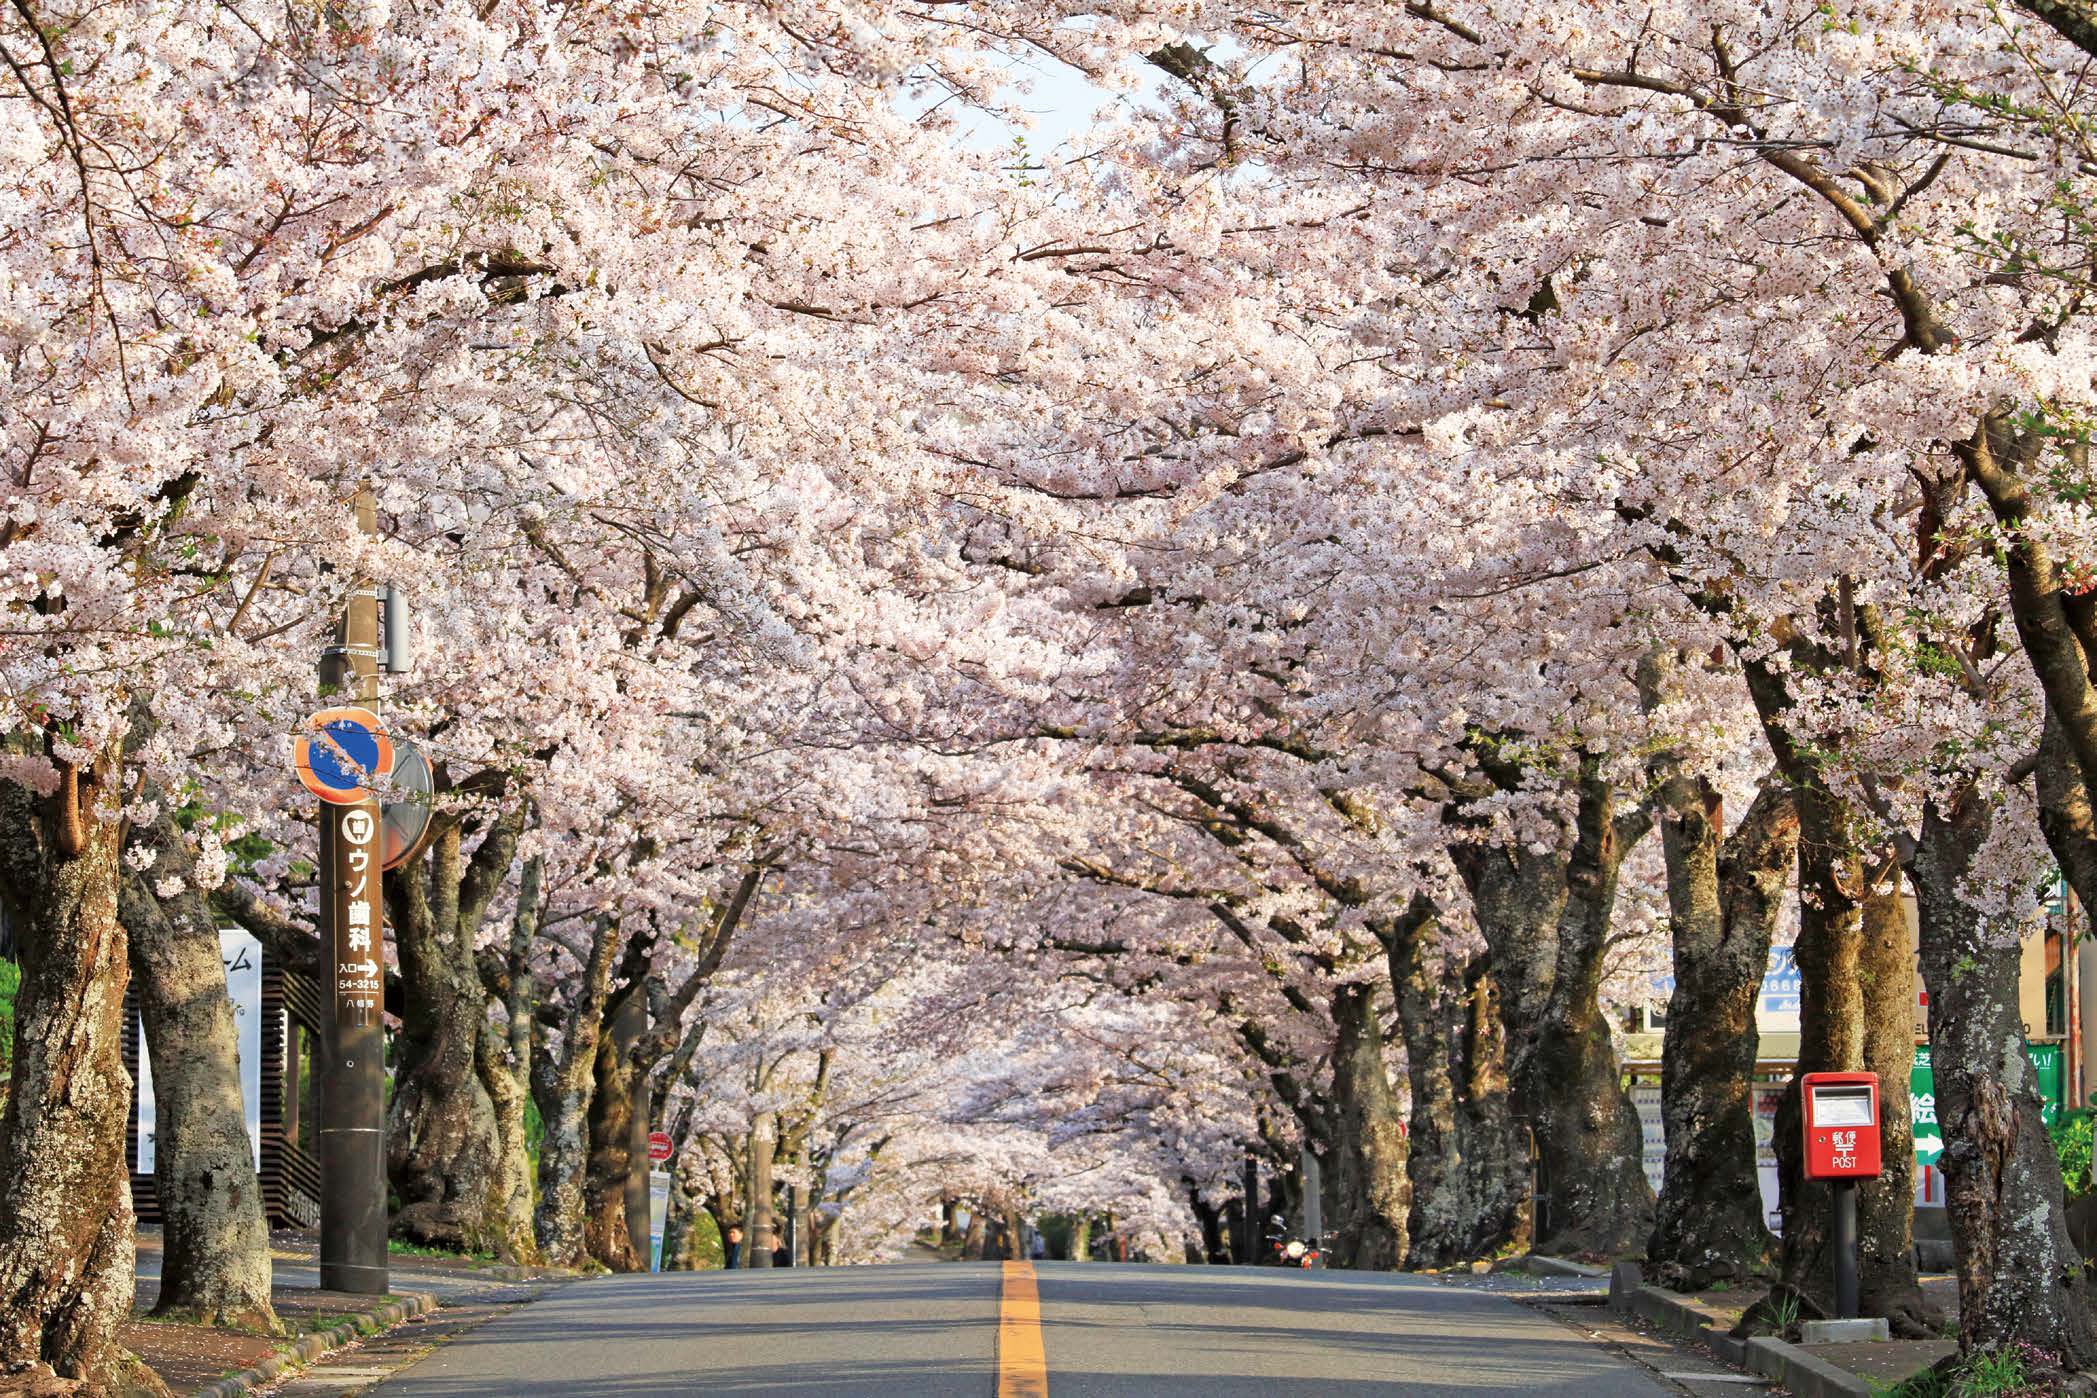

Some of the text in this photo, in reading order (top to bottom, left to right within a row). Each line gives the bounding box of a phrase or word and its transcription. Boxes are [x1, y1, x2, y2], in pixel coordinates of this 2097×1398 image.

[348, 848, 371, 951] ウノ歯科
[224, 947, 252, 972] ム
[339, 963, 357, 973] 入口
[339, 979, 379, 989] 54-3215
[1832, 1130, 1857, 1145] 郵便
[1832, 1156, 1857, 1169] POST
